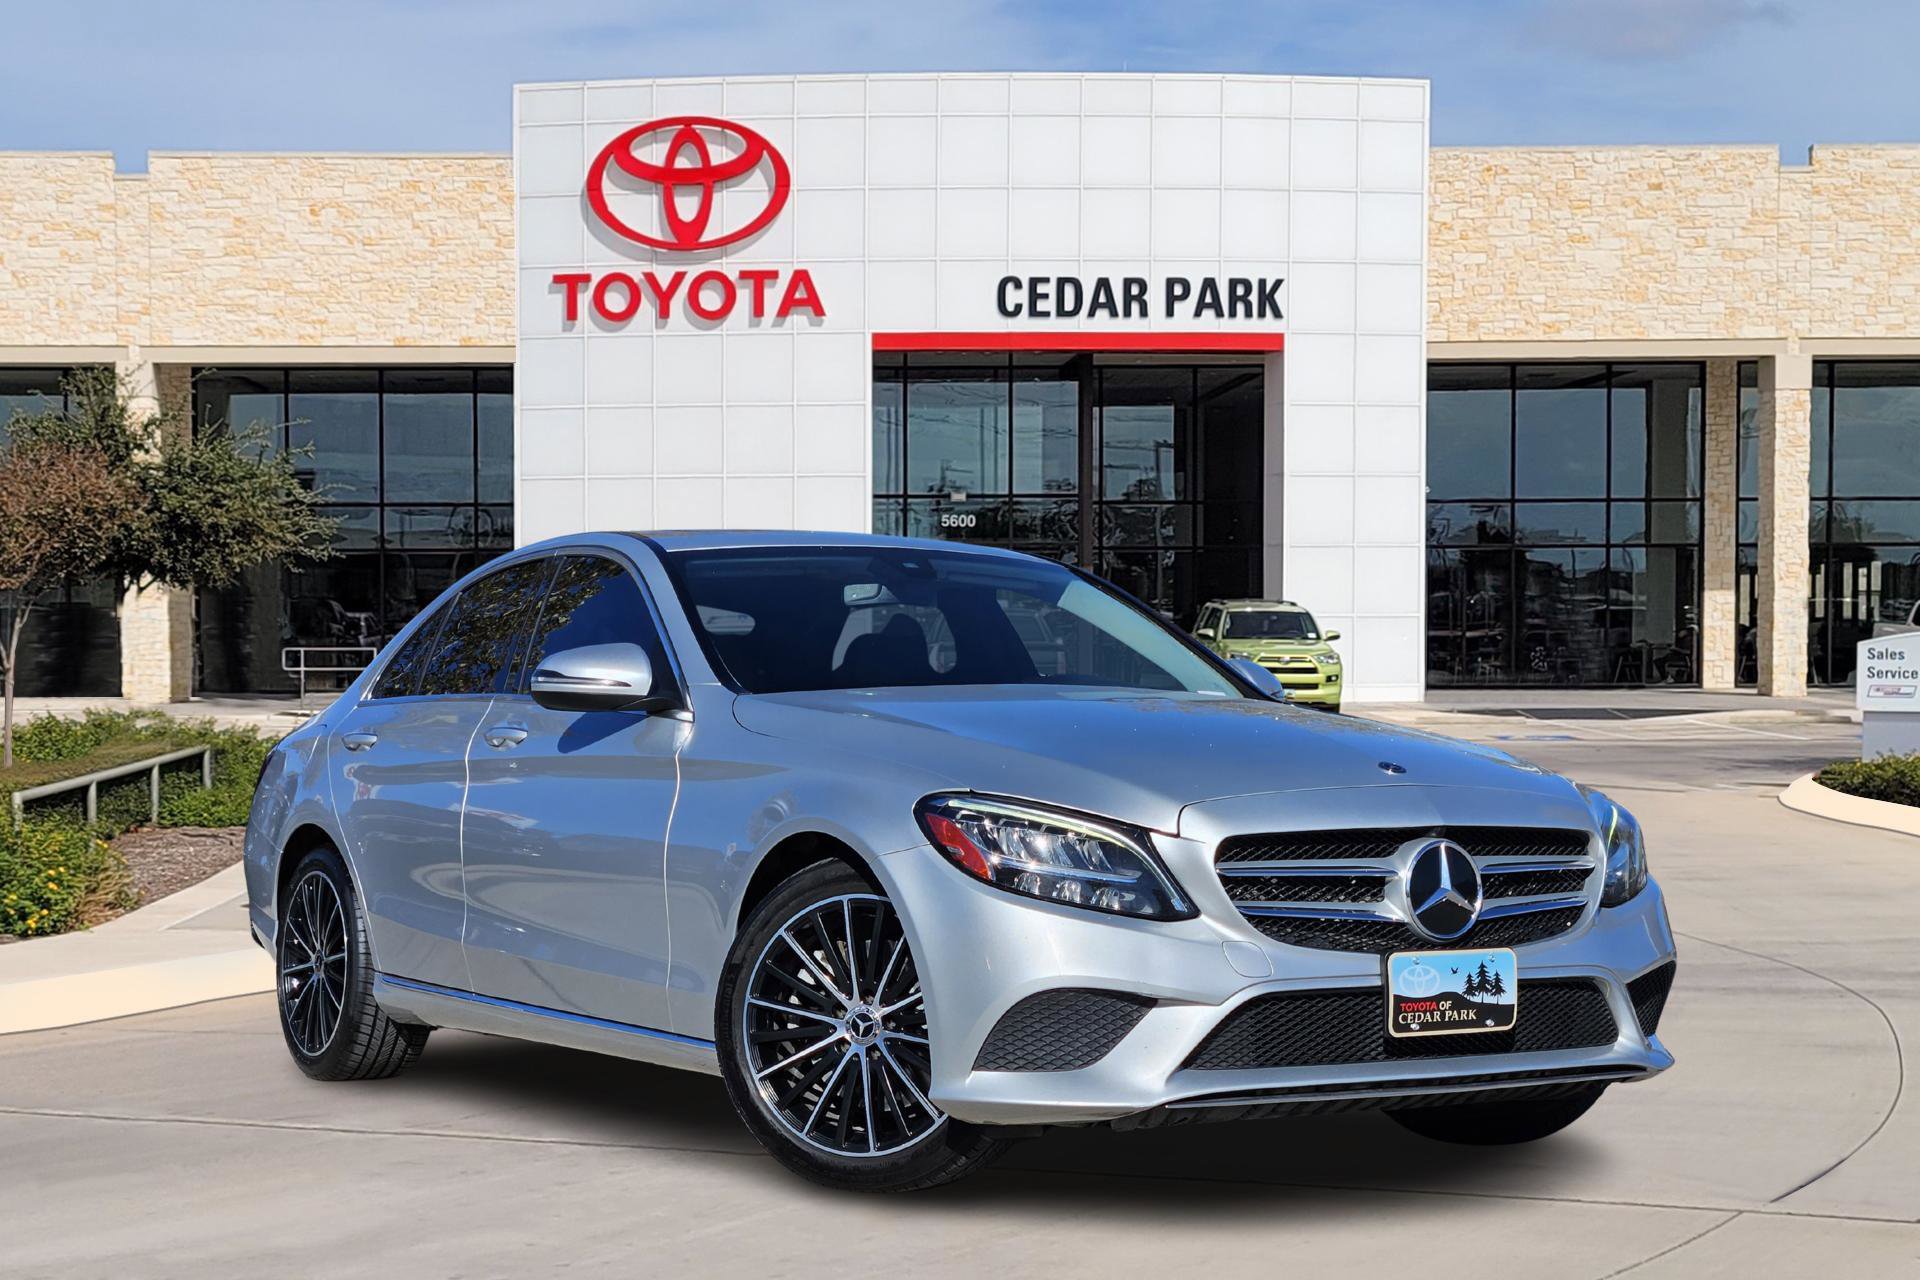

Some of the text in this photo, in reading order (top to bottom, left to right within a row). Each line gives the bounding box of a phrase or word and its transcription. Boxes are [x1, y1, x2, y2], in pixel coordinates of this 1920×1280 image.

[552, 269, 827, 322] TOYOTA
[996, 276, 1285, 319] CEDAR PARK
[941, 514, 977, 528] 5600
[1867, 647, 1905, 661] Sales
[1867, 666, 1919, 679] Service
[1400, 1001, 1452, 1012] TOYOTA OF
[1398, 1009, 1477, 1024] CEDAR PARK
